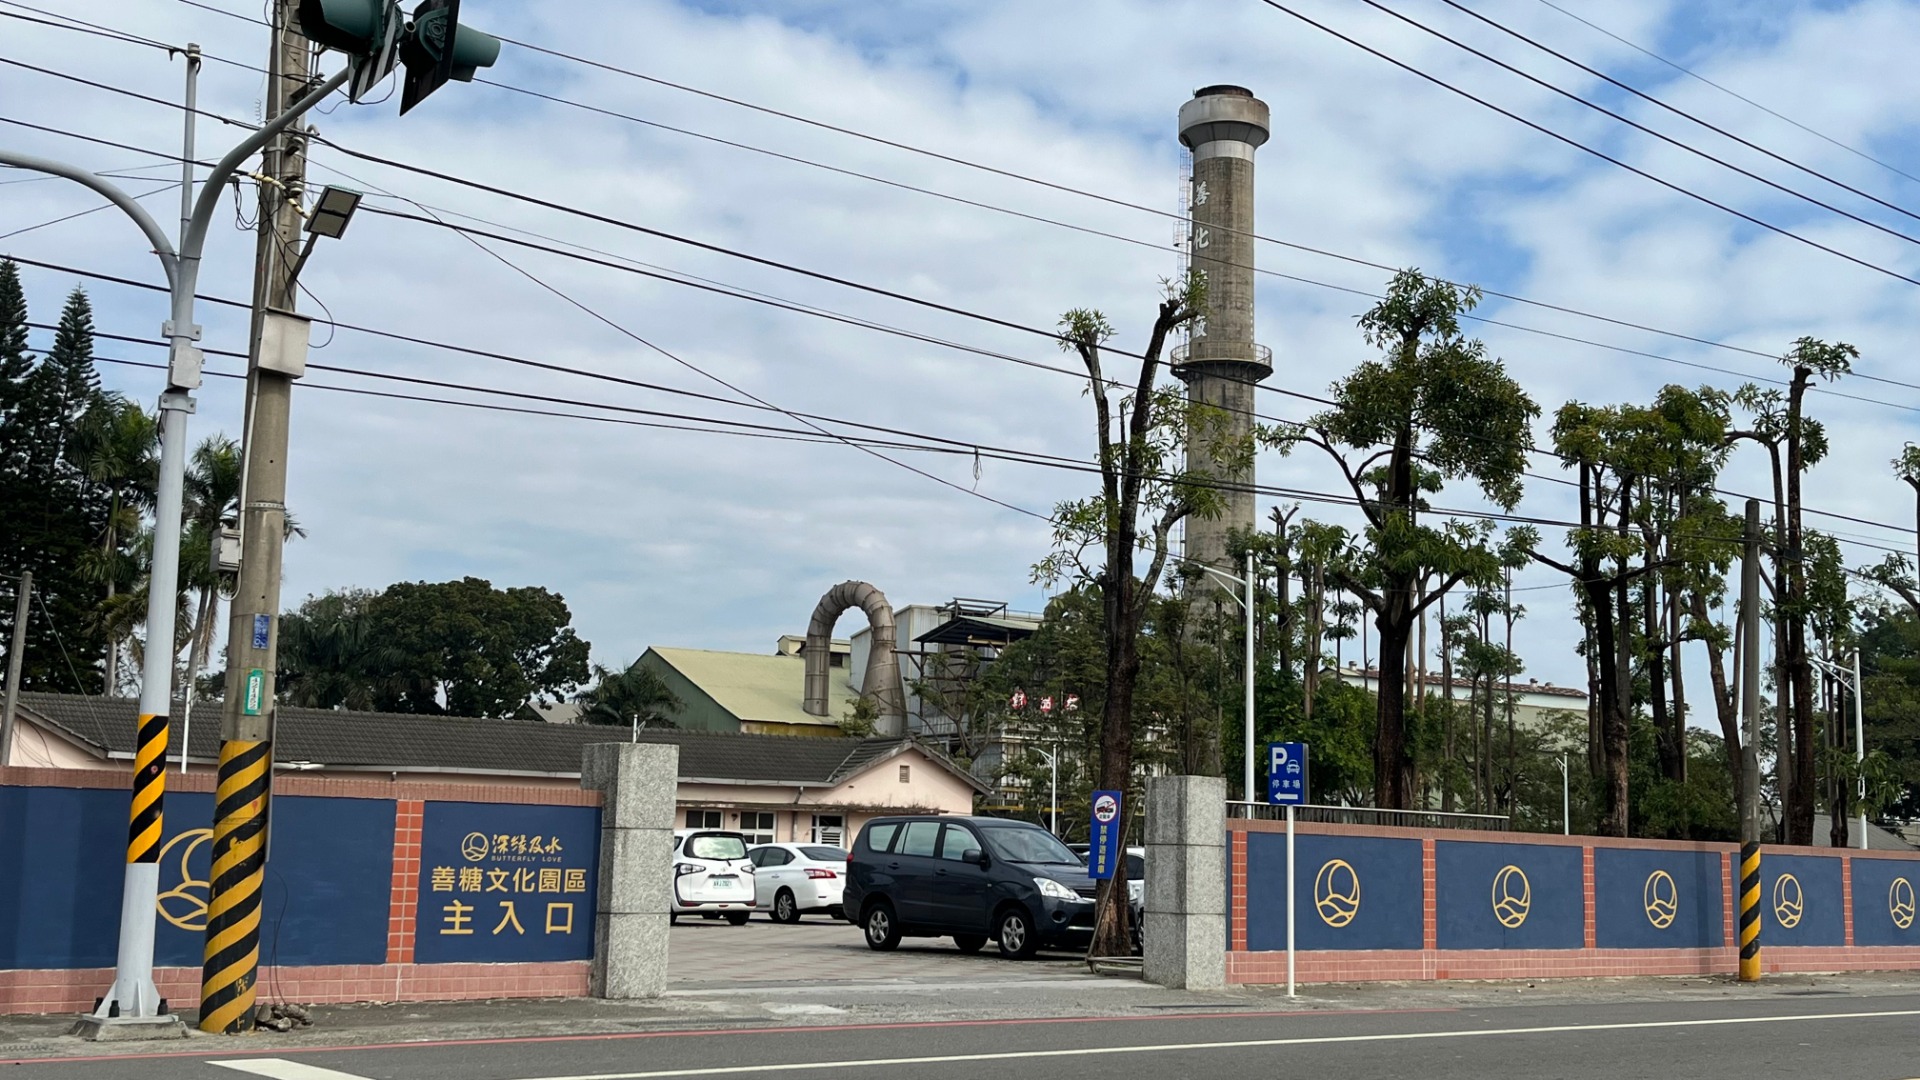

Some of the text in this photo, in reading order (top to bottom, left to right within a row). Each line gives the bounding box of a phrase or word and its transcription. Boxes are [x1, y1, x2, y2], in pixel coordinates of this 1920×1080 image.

[1192, 181, 1210, 338] 善化廠
[1271, 747, 1288, 774] P
[1272, 779, 1301, 789] 停車場
[431, 866, 586, 894] 善糖文化園區
[440, 900, 574, 935] 主入口
